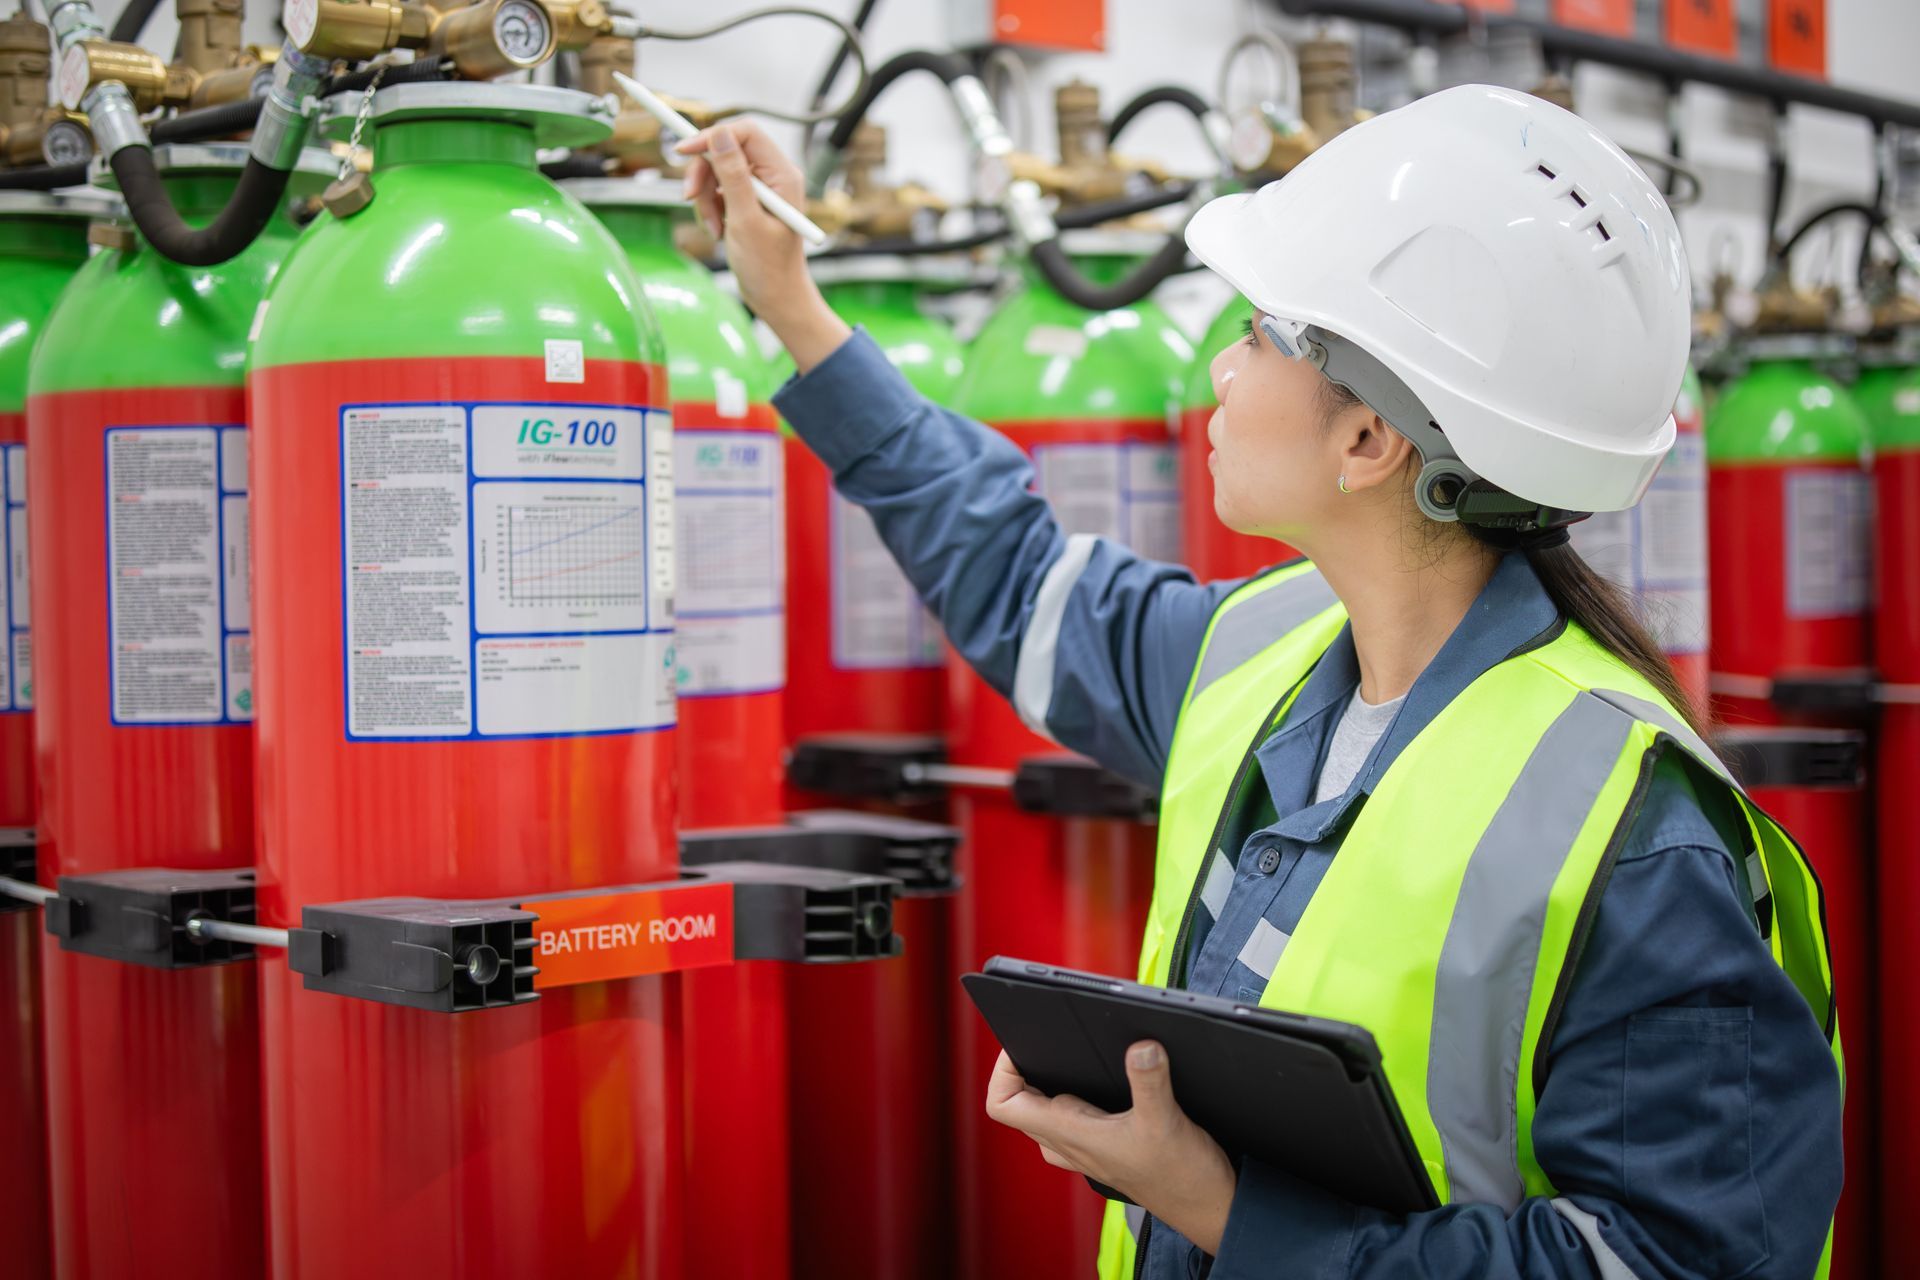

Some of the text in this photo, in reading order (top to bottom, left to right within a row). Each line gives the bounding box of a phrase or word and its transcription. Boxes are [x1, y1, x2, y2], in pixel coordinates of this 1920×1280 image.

[517, 418, 617, 446] IG-100
[540, 914, 716, 956] BATTERY ROOM
